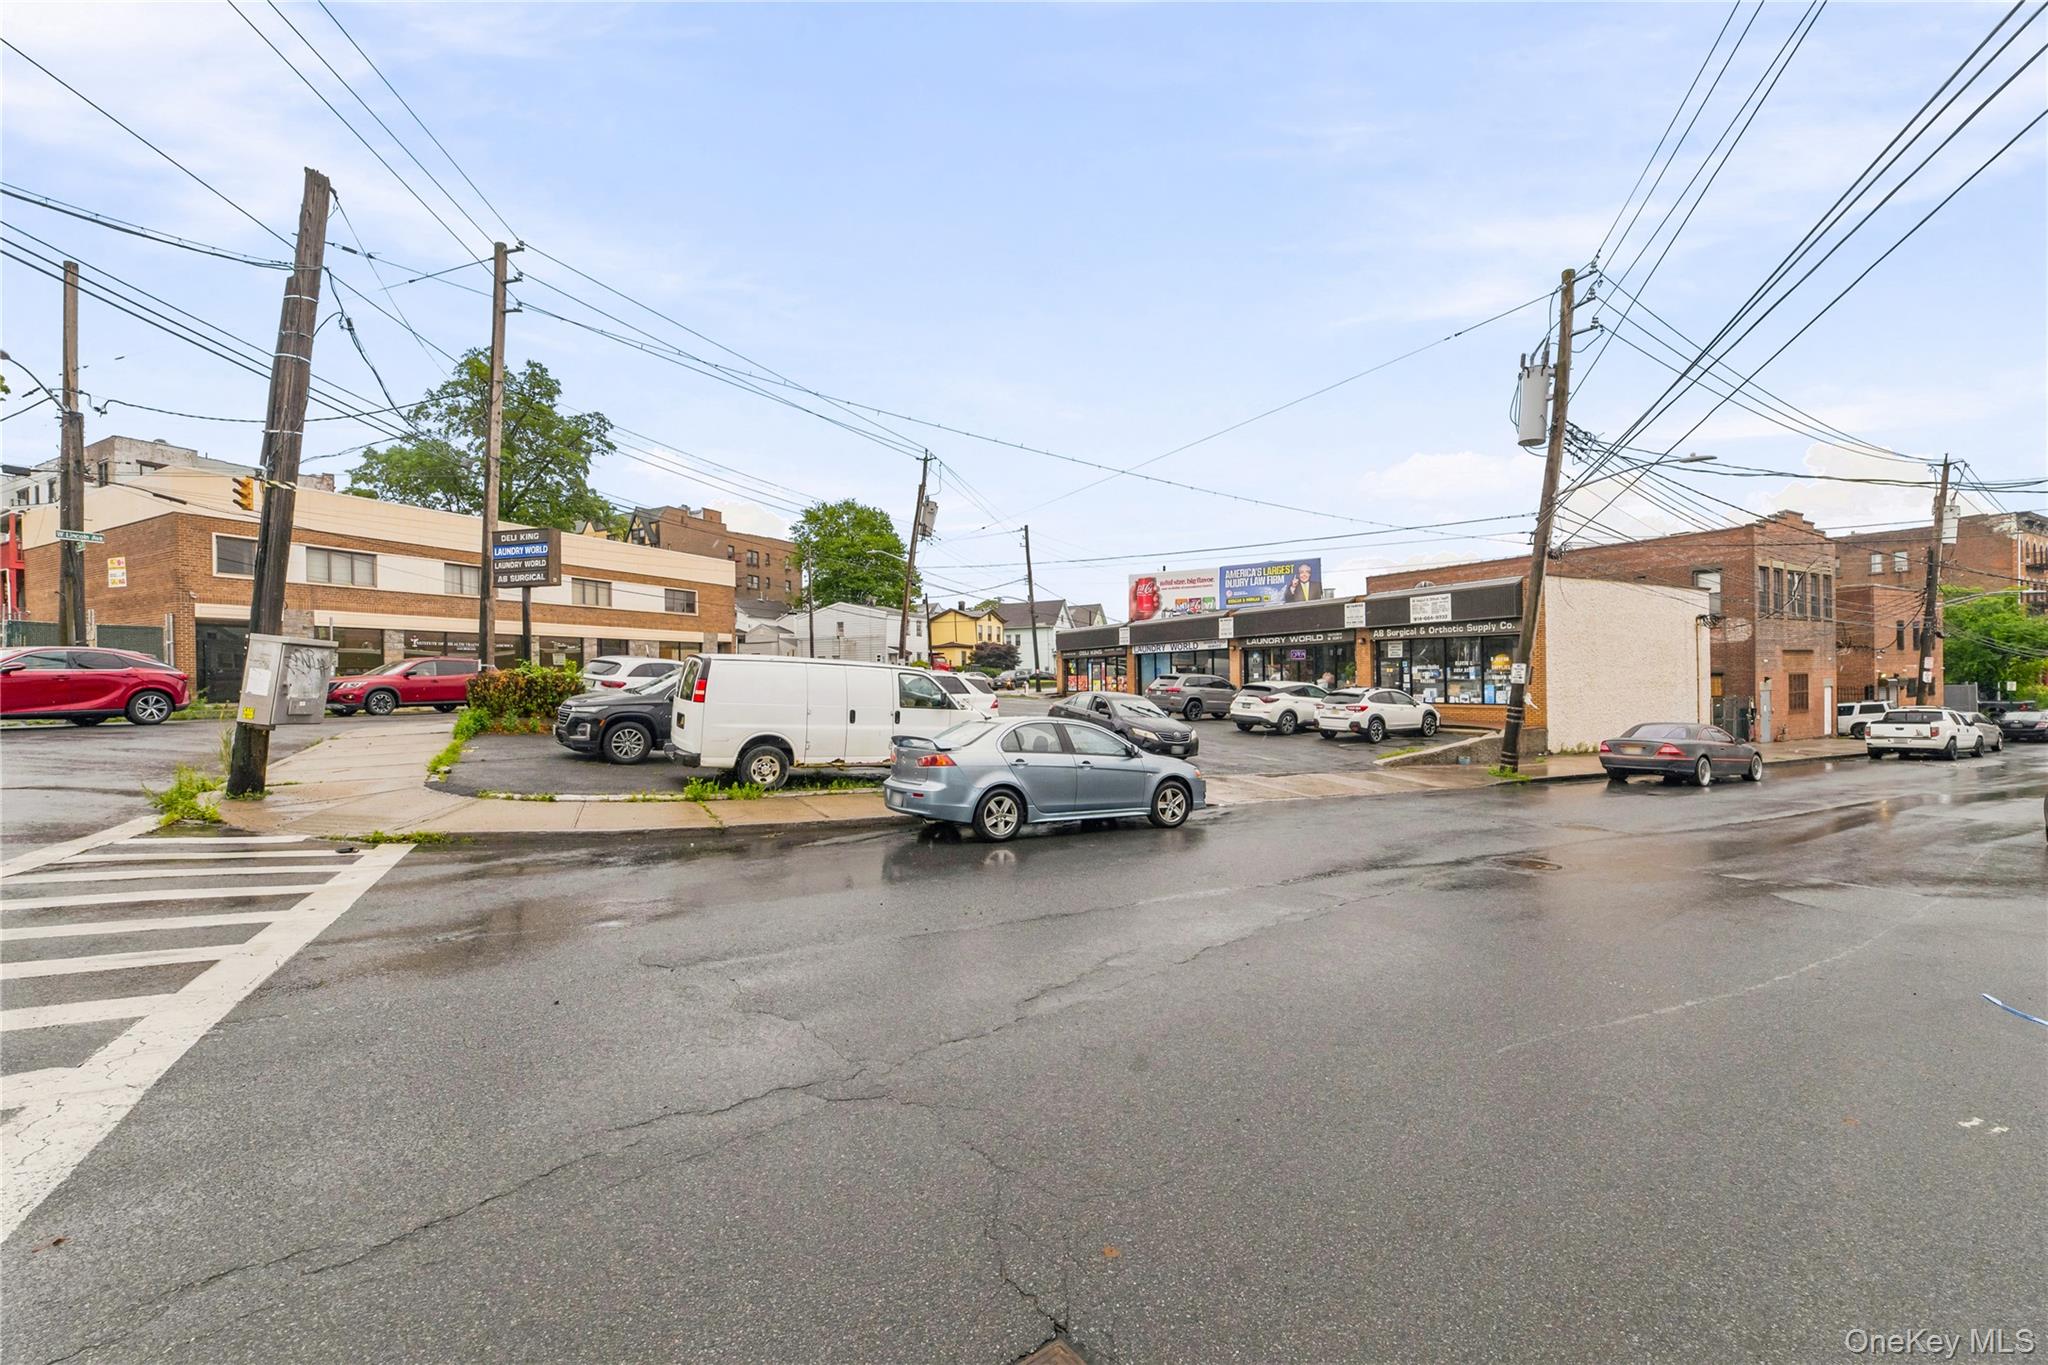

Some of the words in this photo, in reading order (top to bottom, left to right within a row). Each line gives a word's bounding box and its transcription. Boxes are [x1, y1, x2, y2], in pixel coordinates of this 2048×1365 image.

[66, 532, 89, 540] Lincoln
[501, 534, 517, 542] DELI
[494, 546, 523, 556] LAUNDRY
[525, 545, 548, 554] WORLD
[494, 561, 522, 569] LAUNDRY
[1226, 568, 1262, 578] AMERICA'S
[1263, 564, 1294, 576] LARGEST
[510, 574, 546, 582] SURGICAL
[1225, 578, 1248, 588] INJURY
[1250, 576, 1266, 586] LAW
[1267, 575, 1285, 585] FIRM
[1373, 629, 1384, 638] AB
[1387, 628, 1416, 637] Surgical
[1428, 624, 1463, 634] Orthotic
[1467, 622, 1496, 632] Supply
[1500, 621, 1515, 629] Co.
[1246, 636, 1286, 645] LAUNDRY
[1289, 634, 1324, 643] WORLD
[1134, 644, 1166, 652] LAUNDRY
[1170, 642, 1198, 650] WORLD
